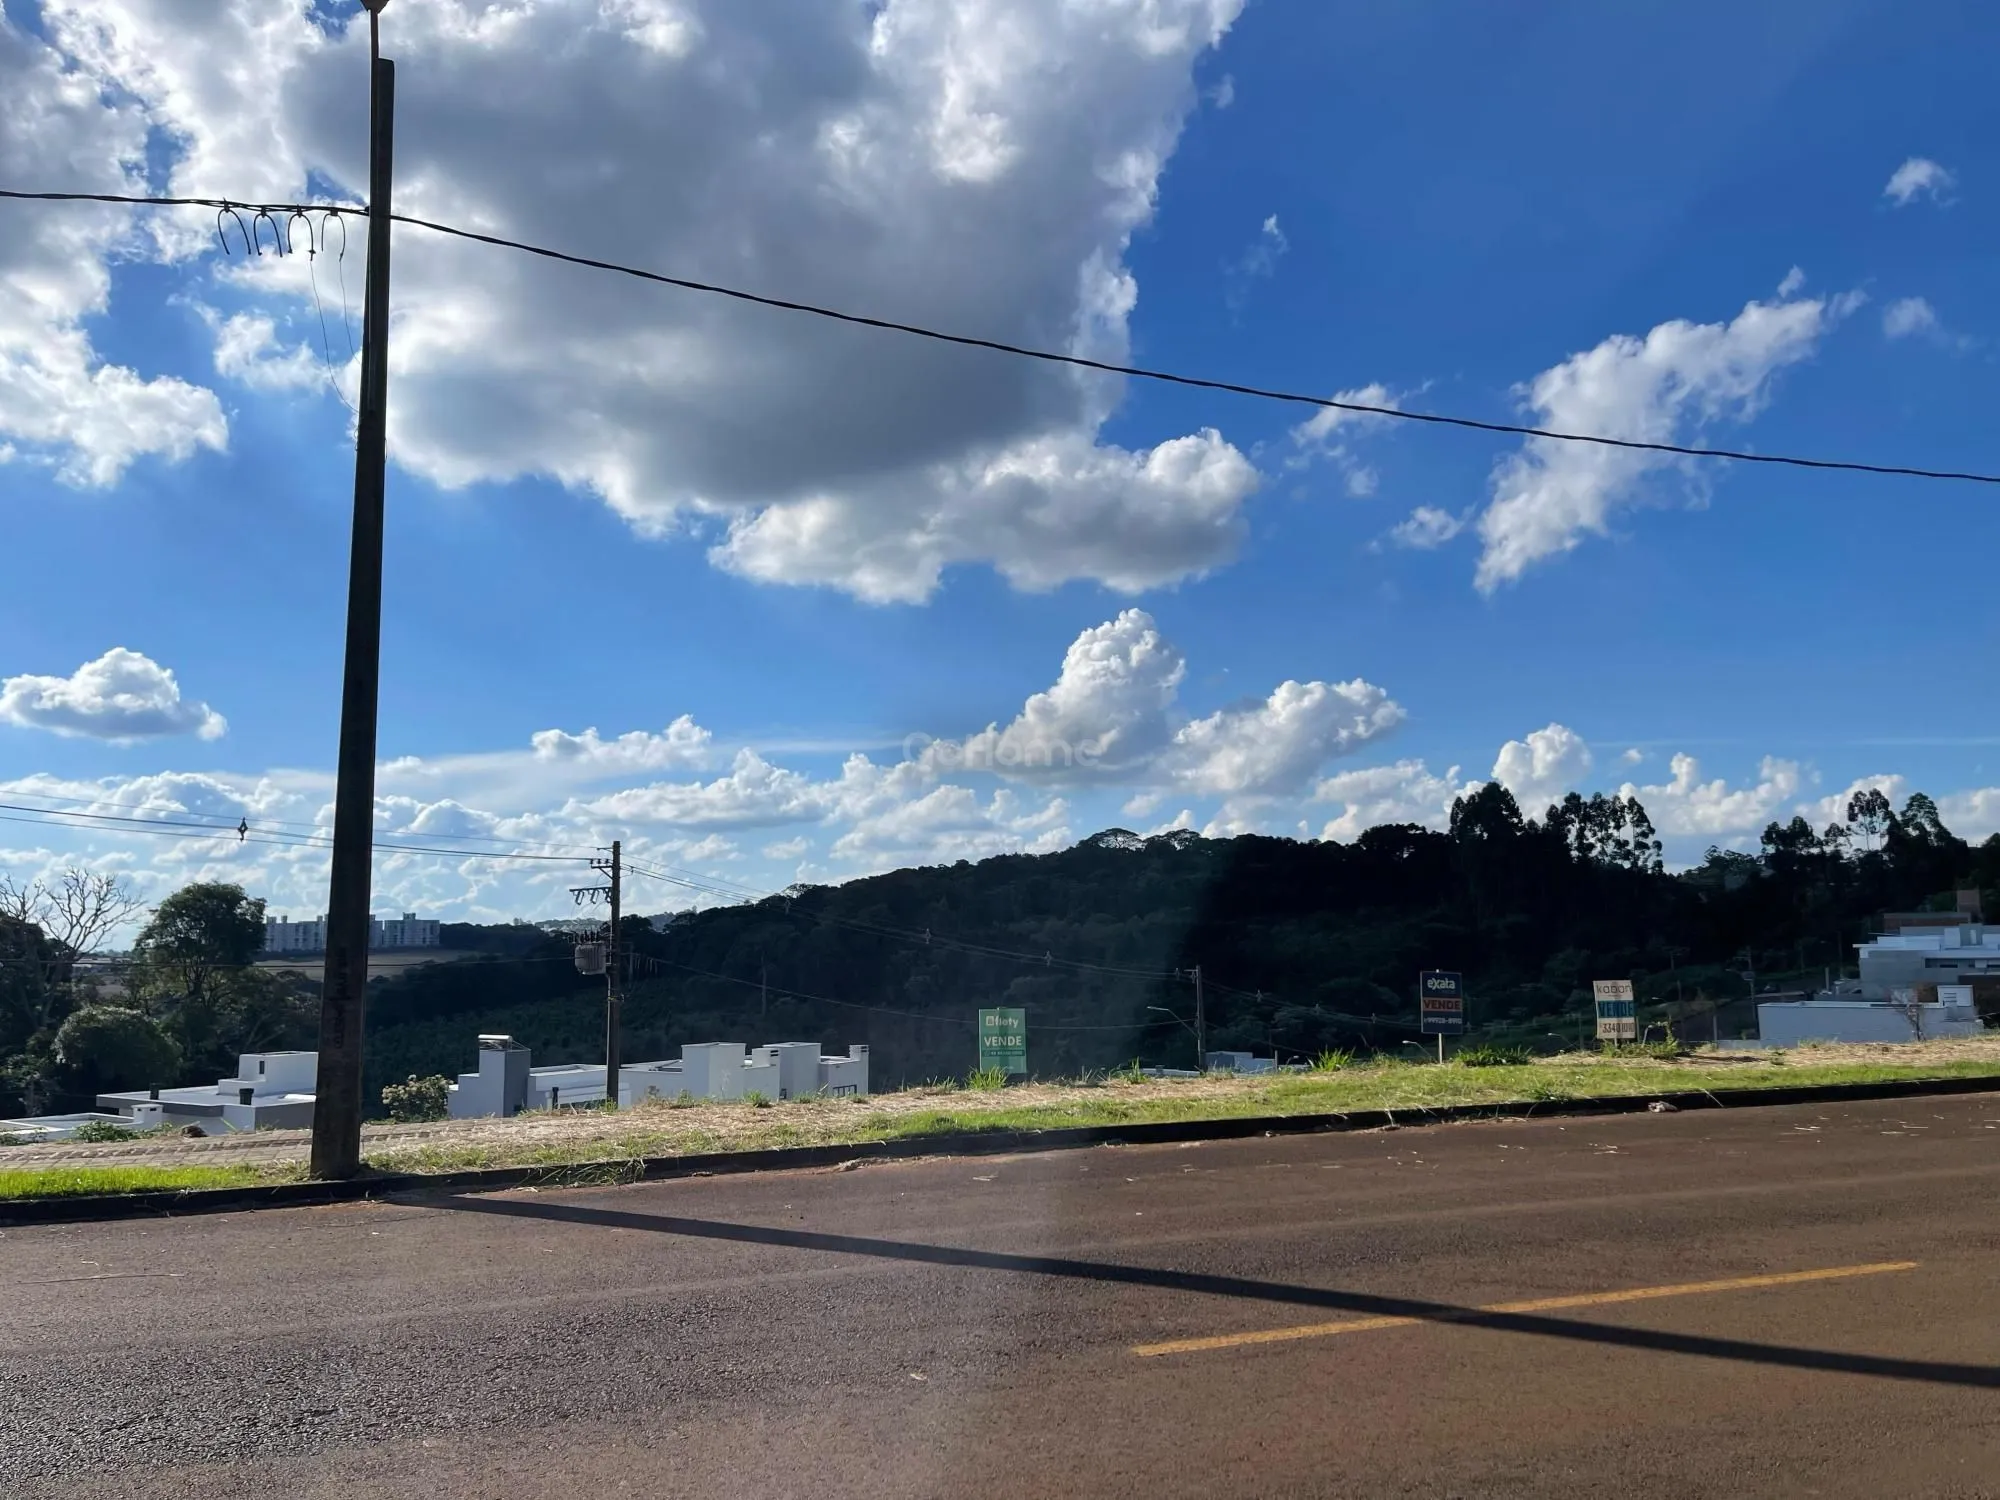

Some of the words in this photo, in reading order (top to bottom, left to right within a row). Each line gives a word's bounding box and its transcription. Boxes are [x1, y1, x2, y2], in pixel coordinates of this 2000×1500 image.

[1423, 1000, 1461, 1010] VENDE
[1599, 1001, 1633, 1016] VENDE
[984, 1036, 1022, 1047] VENDE
